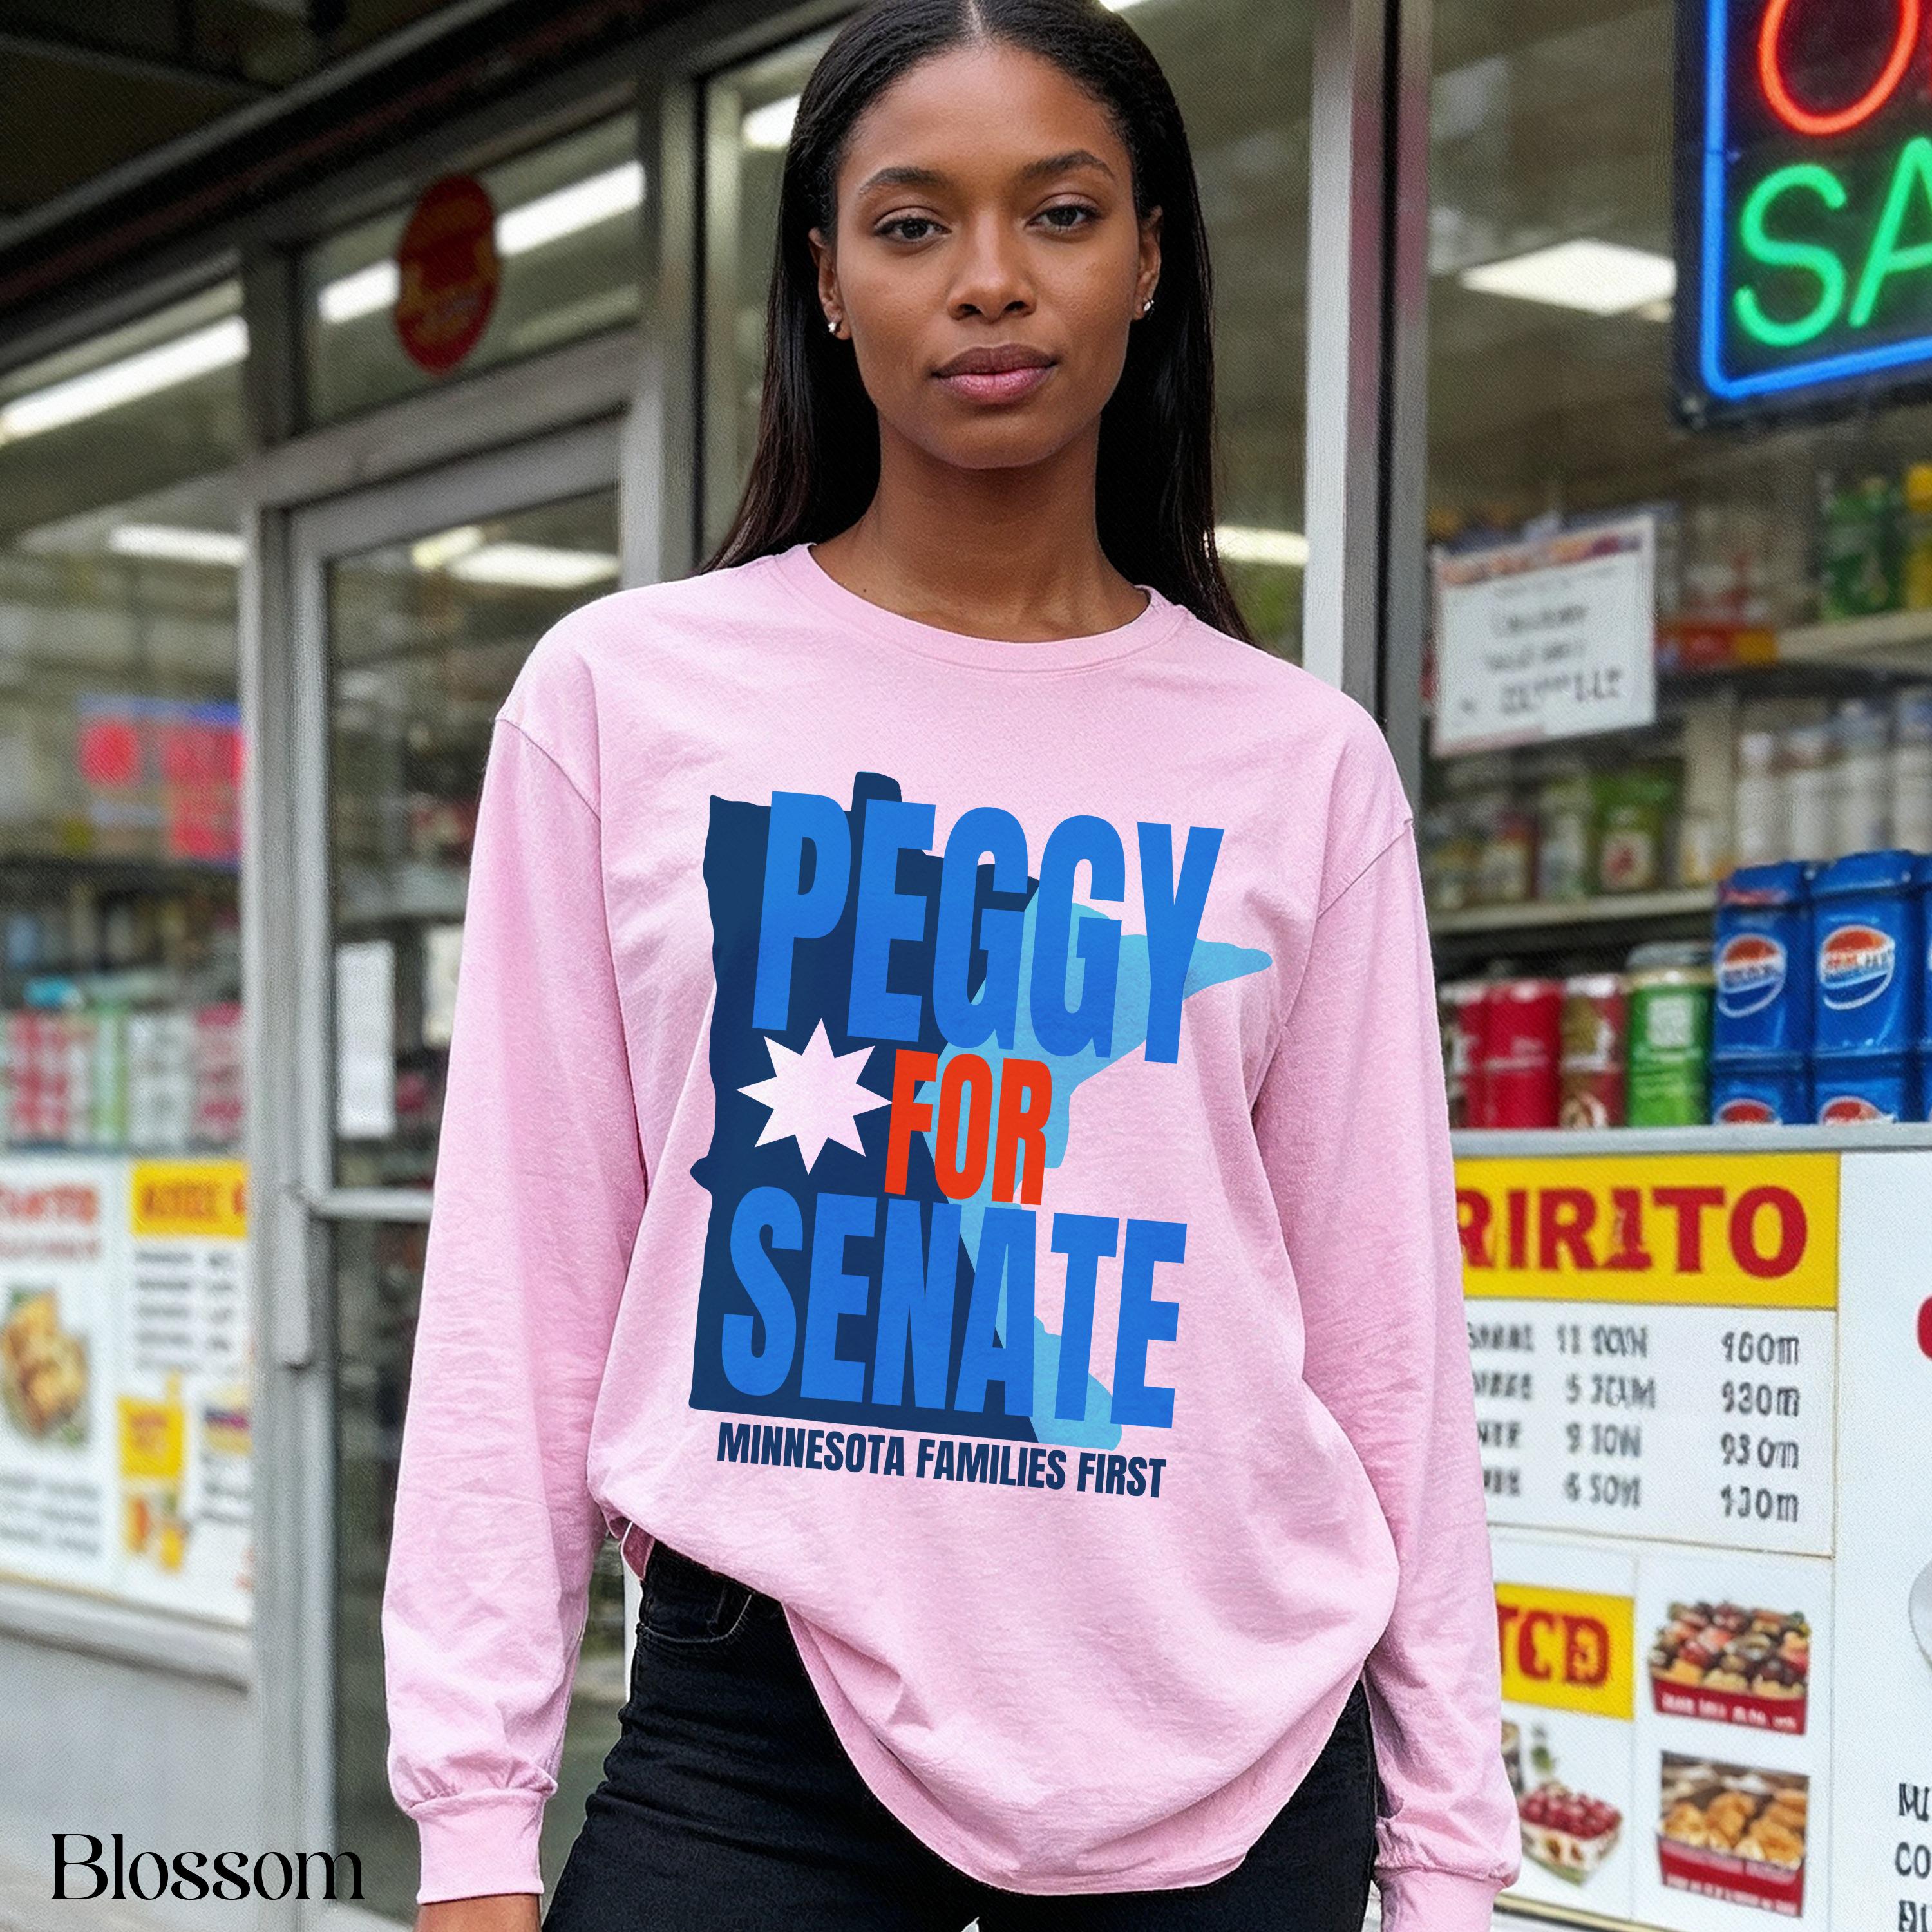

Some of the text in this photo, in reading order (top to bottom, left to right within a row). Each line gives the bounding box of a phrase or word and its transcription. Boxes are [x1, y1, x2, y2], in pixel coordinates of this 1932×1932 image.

[752, 791, 1224, 1065] PEGGY
[884, 1049, 1052, 1206] FOR
[721, 1186, 1188, 1429] SENATE
[716, 1421, 1166, 1499] MINNESOTA FAMILIES FIRST
